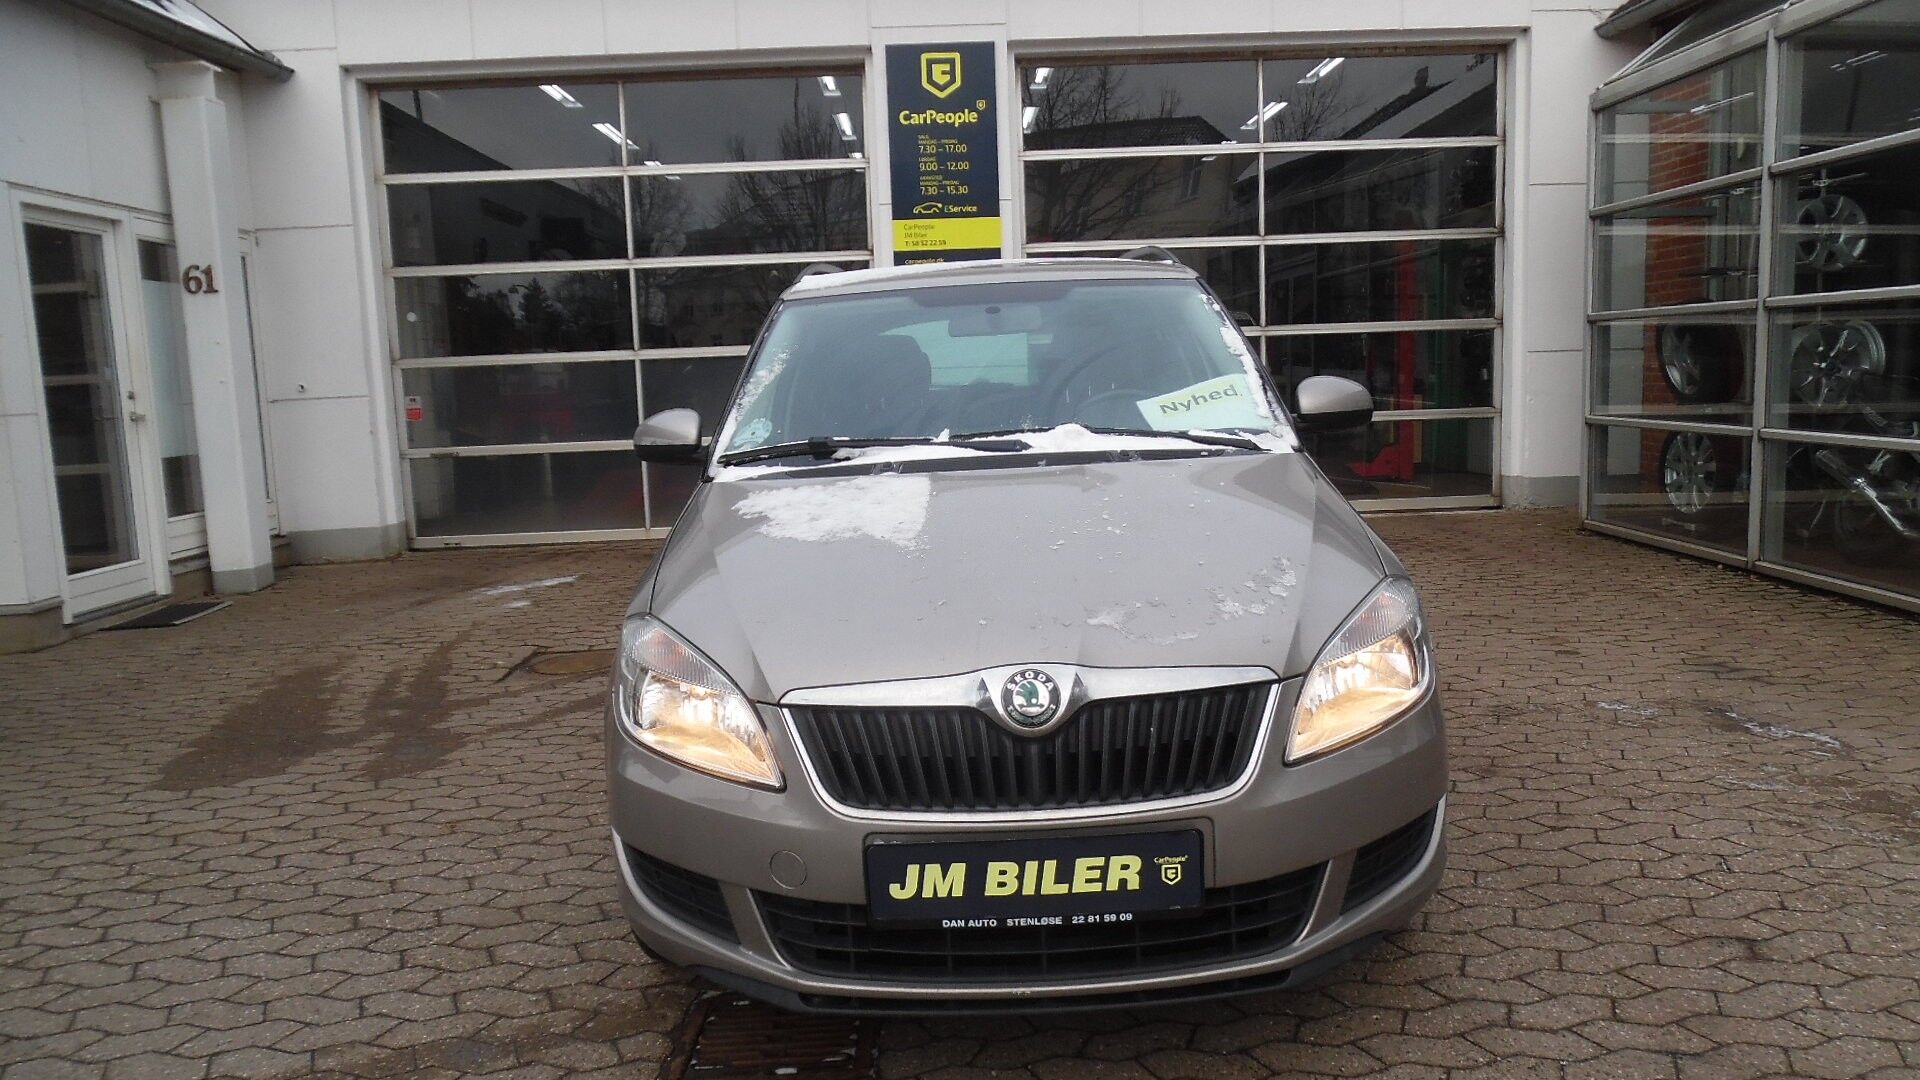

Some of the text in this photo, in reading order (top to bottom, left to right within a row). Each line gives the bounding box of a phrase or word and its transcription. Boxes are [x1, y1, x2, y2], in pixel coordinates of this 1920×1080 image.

[899, 108, 978, 128] CarPeople
[918, 145, 936, 153] 7.30
[945, 144, 967, 153] 17.00
[919, 162, 938, 171] 9.00
[946, 161, 969, 170] 12.00
[920, 186, 938, 195] 7.30
[946, 185, 968, 195] 15.30
[903, 223, 935, 232] CarPeople
[182, 264, 219, 294] 61
[888, 854, 1142, 899] JM BILER
[942, 912, 1132, 928] DAN AUTO STENLØSE 22 81 59 09
